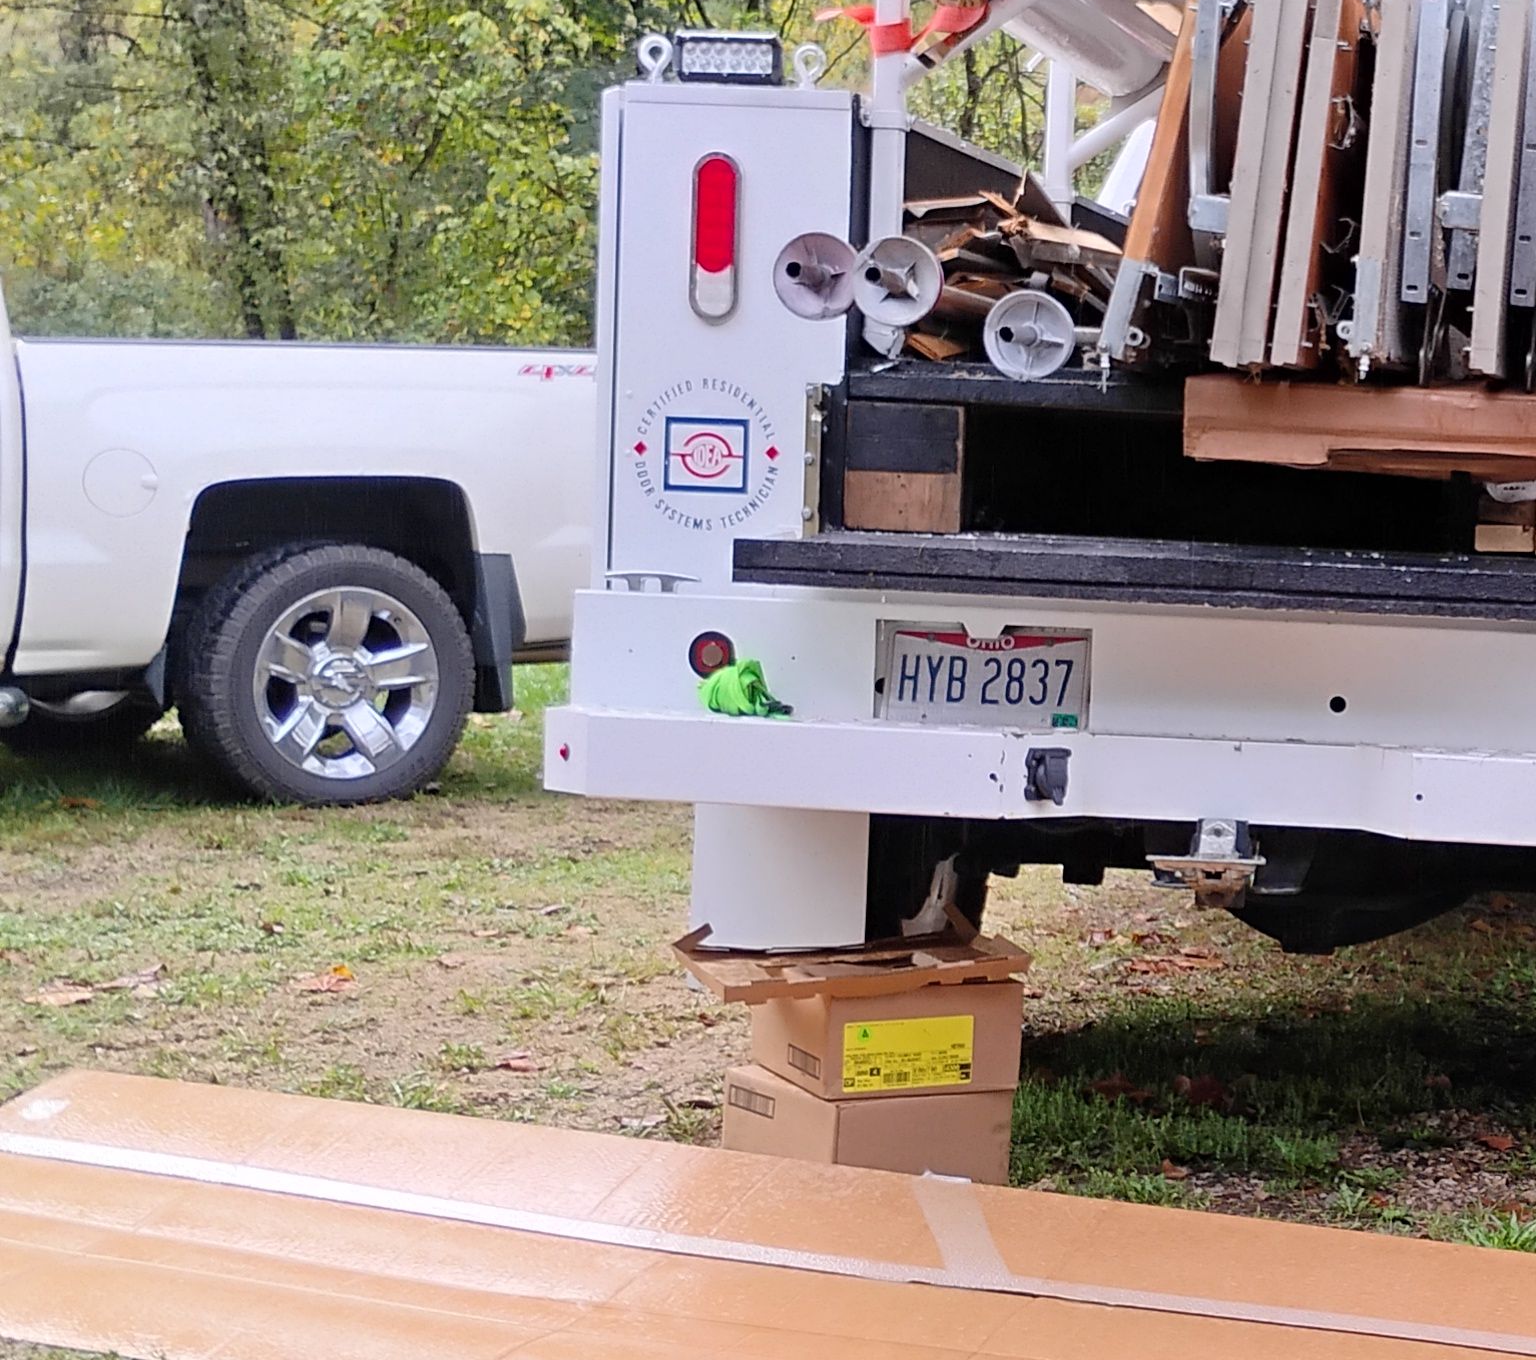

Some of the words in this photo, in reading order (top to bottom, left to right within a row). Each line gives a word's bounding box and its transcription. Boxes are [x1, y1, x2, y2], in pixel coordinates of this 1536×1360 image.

[637, 380, 693, 435] CERTIFIED
[702, 378, 775, 440] RESIDENTIAL
[635, 461, 655, 497] DOOR
[655, 499, 713, 531] SYSTEMS
[720, 466, 779, 529] TECHNICIAN
[898, 654, 968, 703] HYB
[980, 657, 1074, 707] 2837
